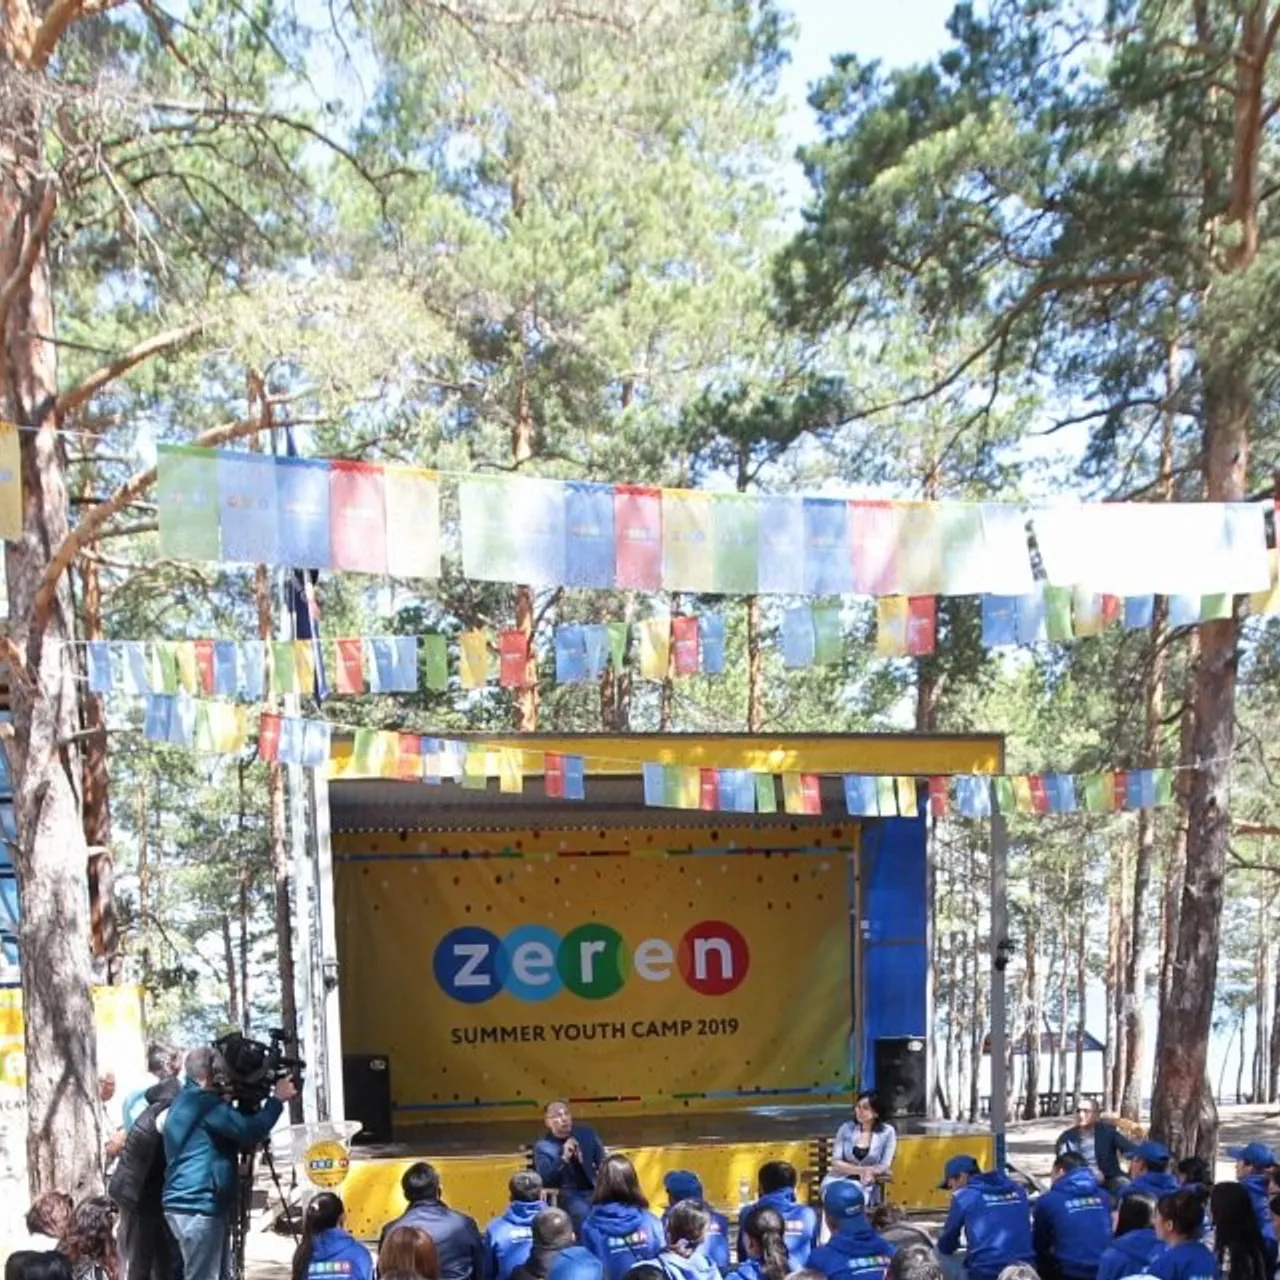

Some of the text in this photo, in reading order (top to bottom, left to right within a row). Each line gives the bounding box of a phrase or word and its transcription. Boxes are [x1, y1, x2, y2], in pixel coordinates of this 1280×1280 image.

[451, 935, 735, 988] zeren
[451, 1017, 740, 1045] SUMMER YOUTH CAMP 2019
